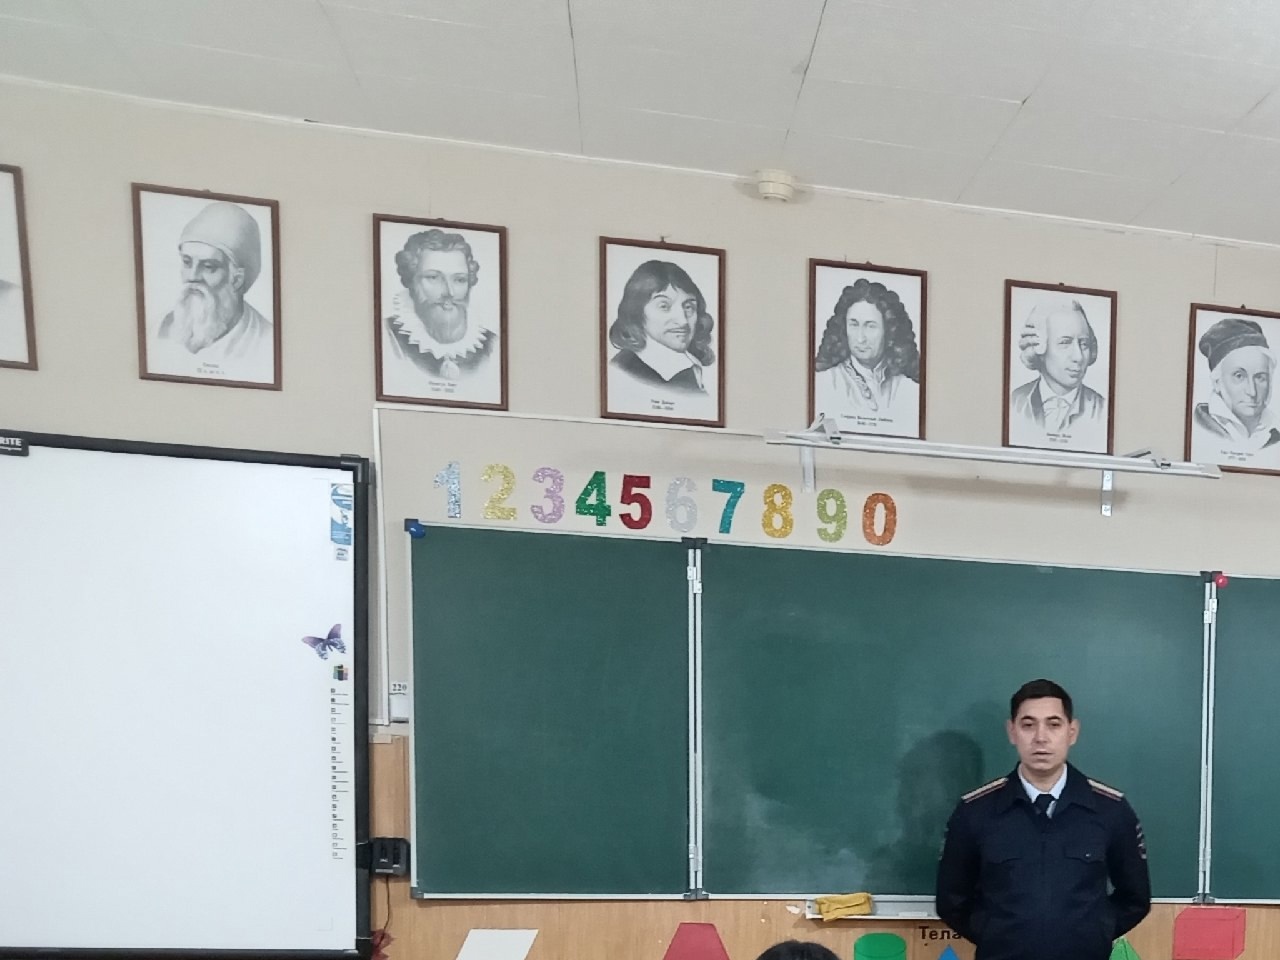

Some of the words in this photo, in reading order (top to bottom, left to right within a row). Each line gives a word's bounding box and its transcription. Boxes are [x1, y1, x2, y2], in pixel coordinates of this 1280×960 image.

[433, 461, 461, 519] 1
[481, 464, 517, 520] 2
[531, 467, 565, 523] 3
[576, 470, 611, 526] 4
[619, 474, 652, 529] 5
[665, 477, 698, 533] 6
[711, 478, 745, 534] 7
[762, 483, 794, 539] 8
[816, 488, 848, 543] 9
[862, 492, 897, 546] 0
[392, 684, 408, 692] 220
